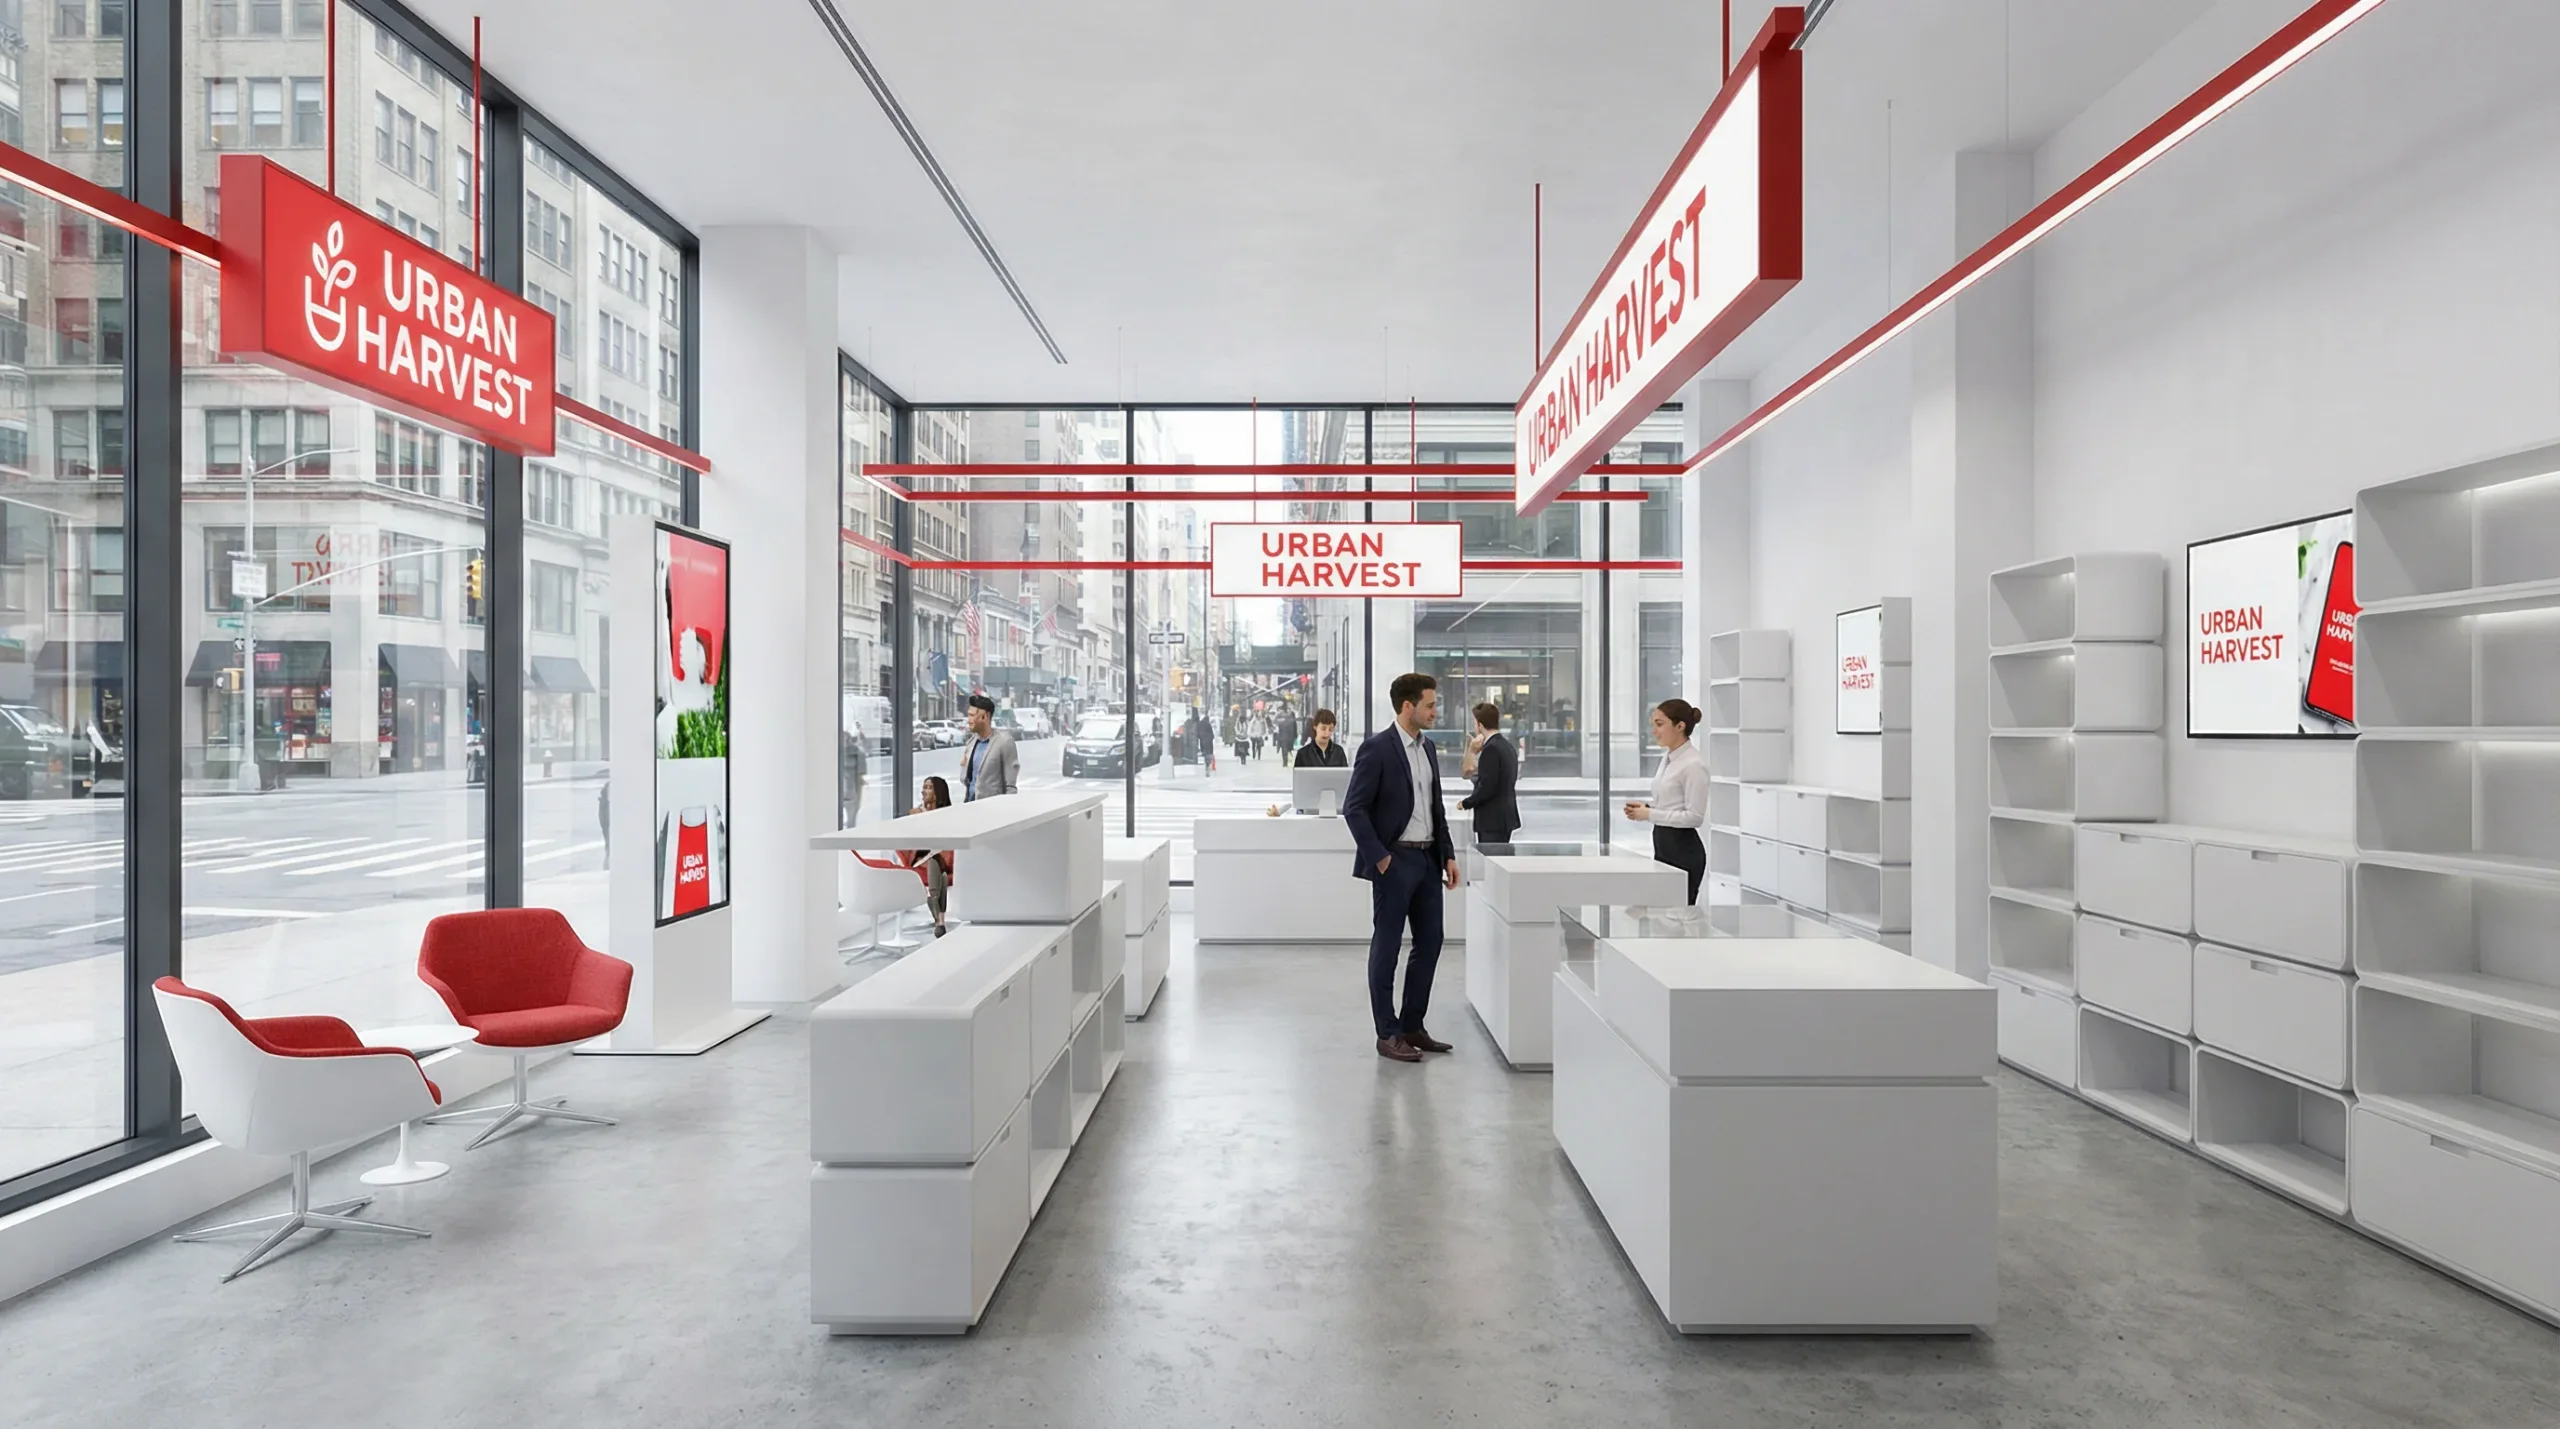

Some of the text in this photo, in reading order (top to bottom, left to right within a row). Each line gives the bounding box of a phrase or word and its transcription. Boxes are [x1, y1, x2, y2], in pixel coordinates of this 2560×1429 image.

[384, 249, 517, 364] URBAN
[1528, 184, 1707, 477] URBAN HARVEST
[358, 304, 533, 425] HARVEST
[1262, 532, 1383, 557] URBAN
[1262, 562, 1422, 588] HARVEST
[2200, 605, 2263, 635] URBAN
[2200, 634, 2284, 664] HARVEST
